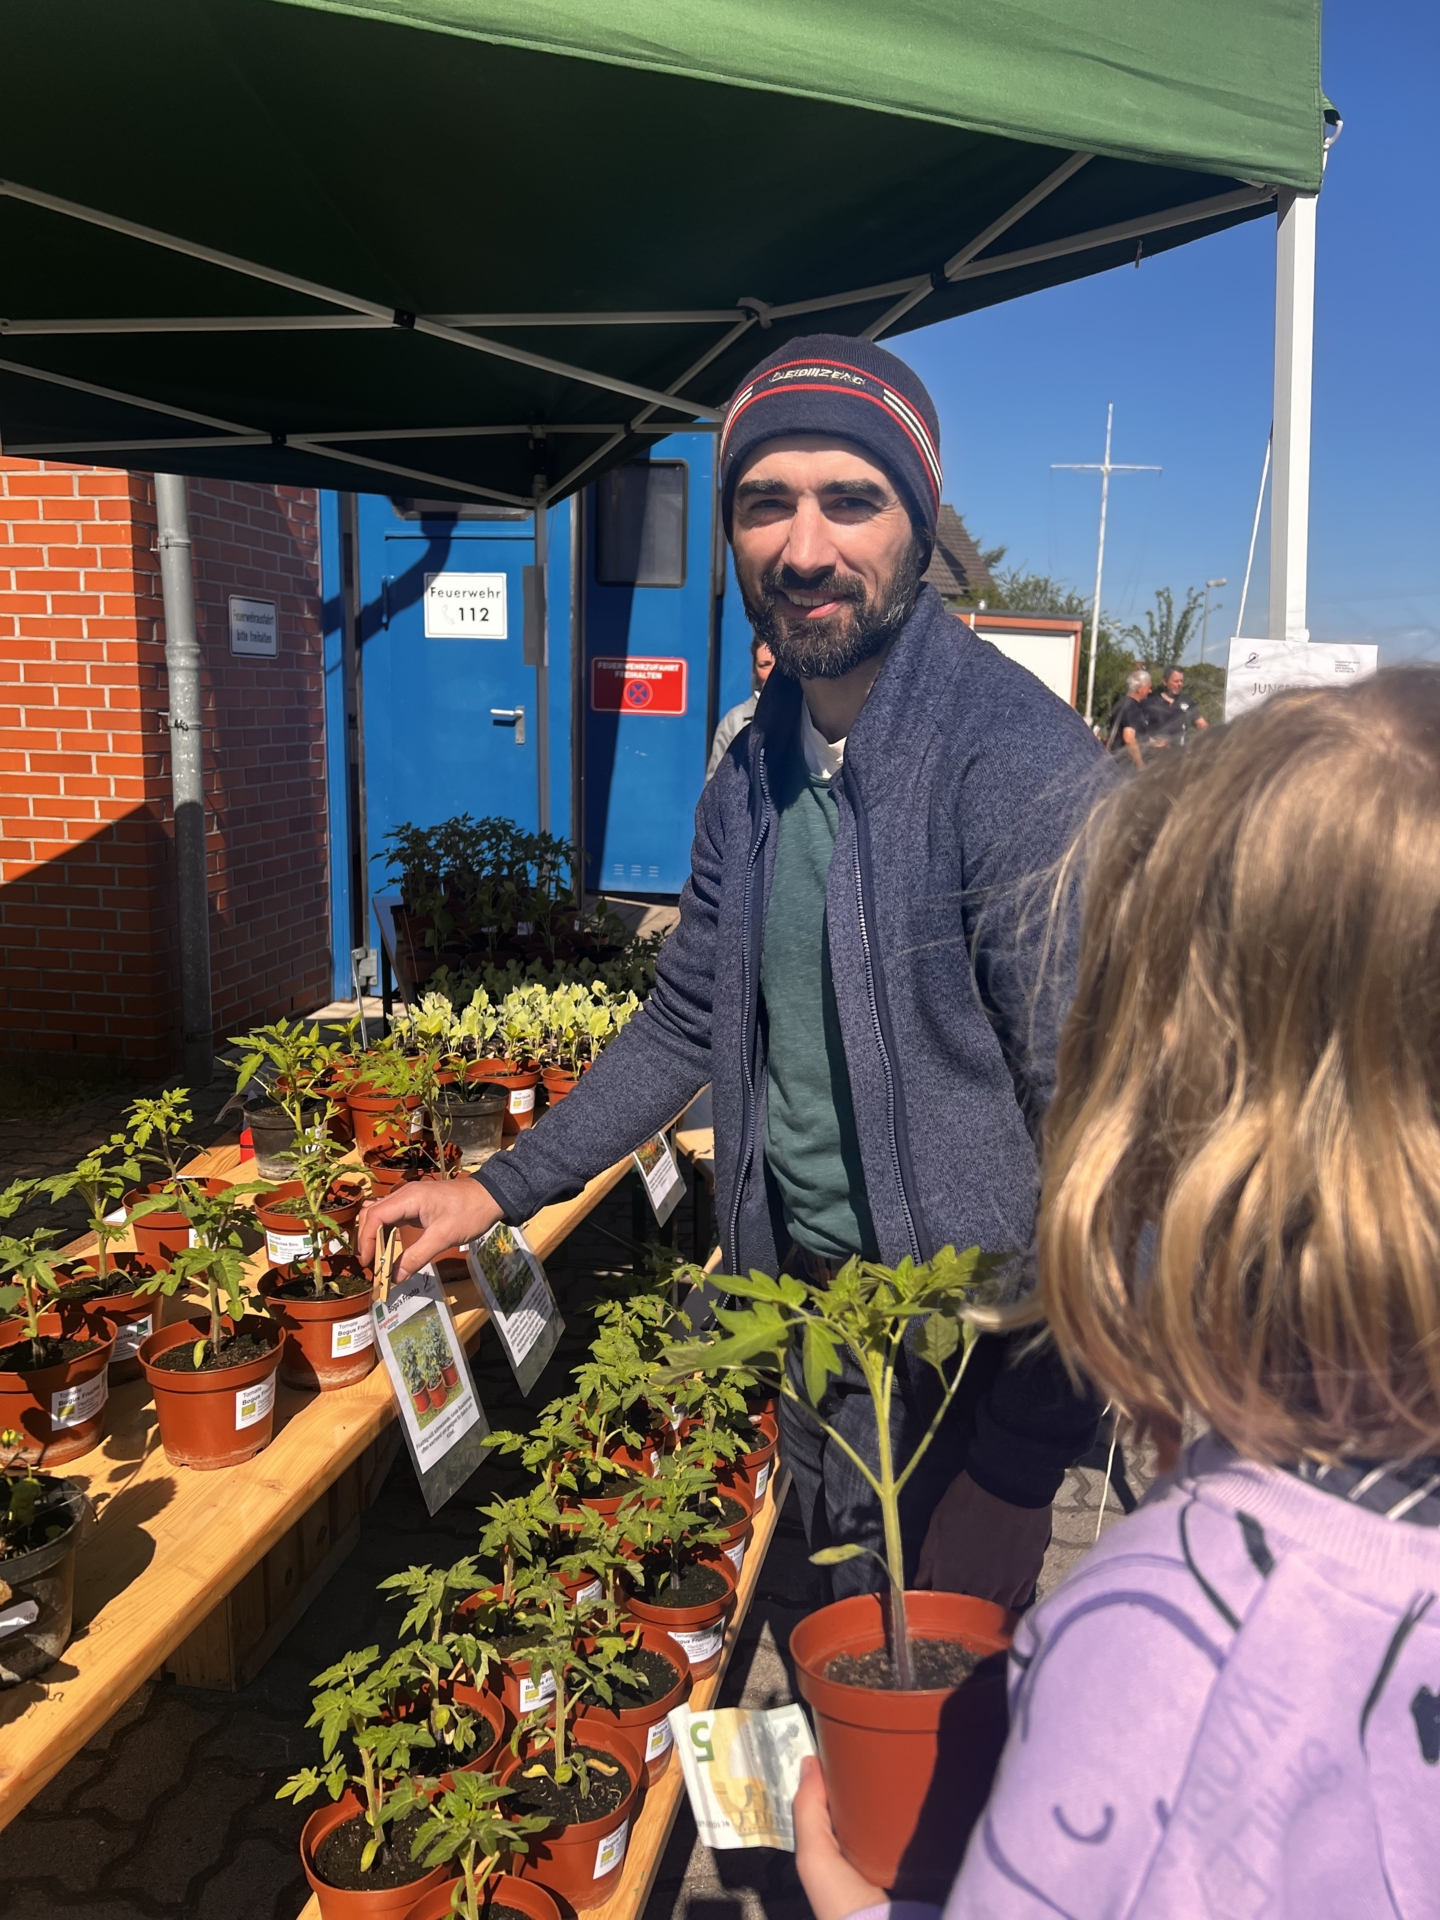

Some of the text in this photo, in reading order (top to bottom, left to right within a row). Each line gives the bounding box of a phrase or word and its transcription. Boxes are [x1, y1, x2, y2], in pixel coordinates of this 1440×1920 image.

[429, 586, 502, 599] Feuerwehr
[458, 607, 490, 622] 112
[614, 670, 663, 680] FREIHALTEN
[338, 1320, 359, 1330] Tomate
[337, 1328, 357, 1337] Bogus
[242, 1386, 263, 1398] Tomate
[58, 1395, 81, 1407] Bogus
[241, 1394, 261, 1406] Bogus
[690, 1721, 715, 1763] 5
